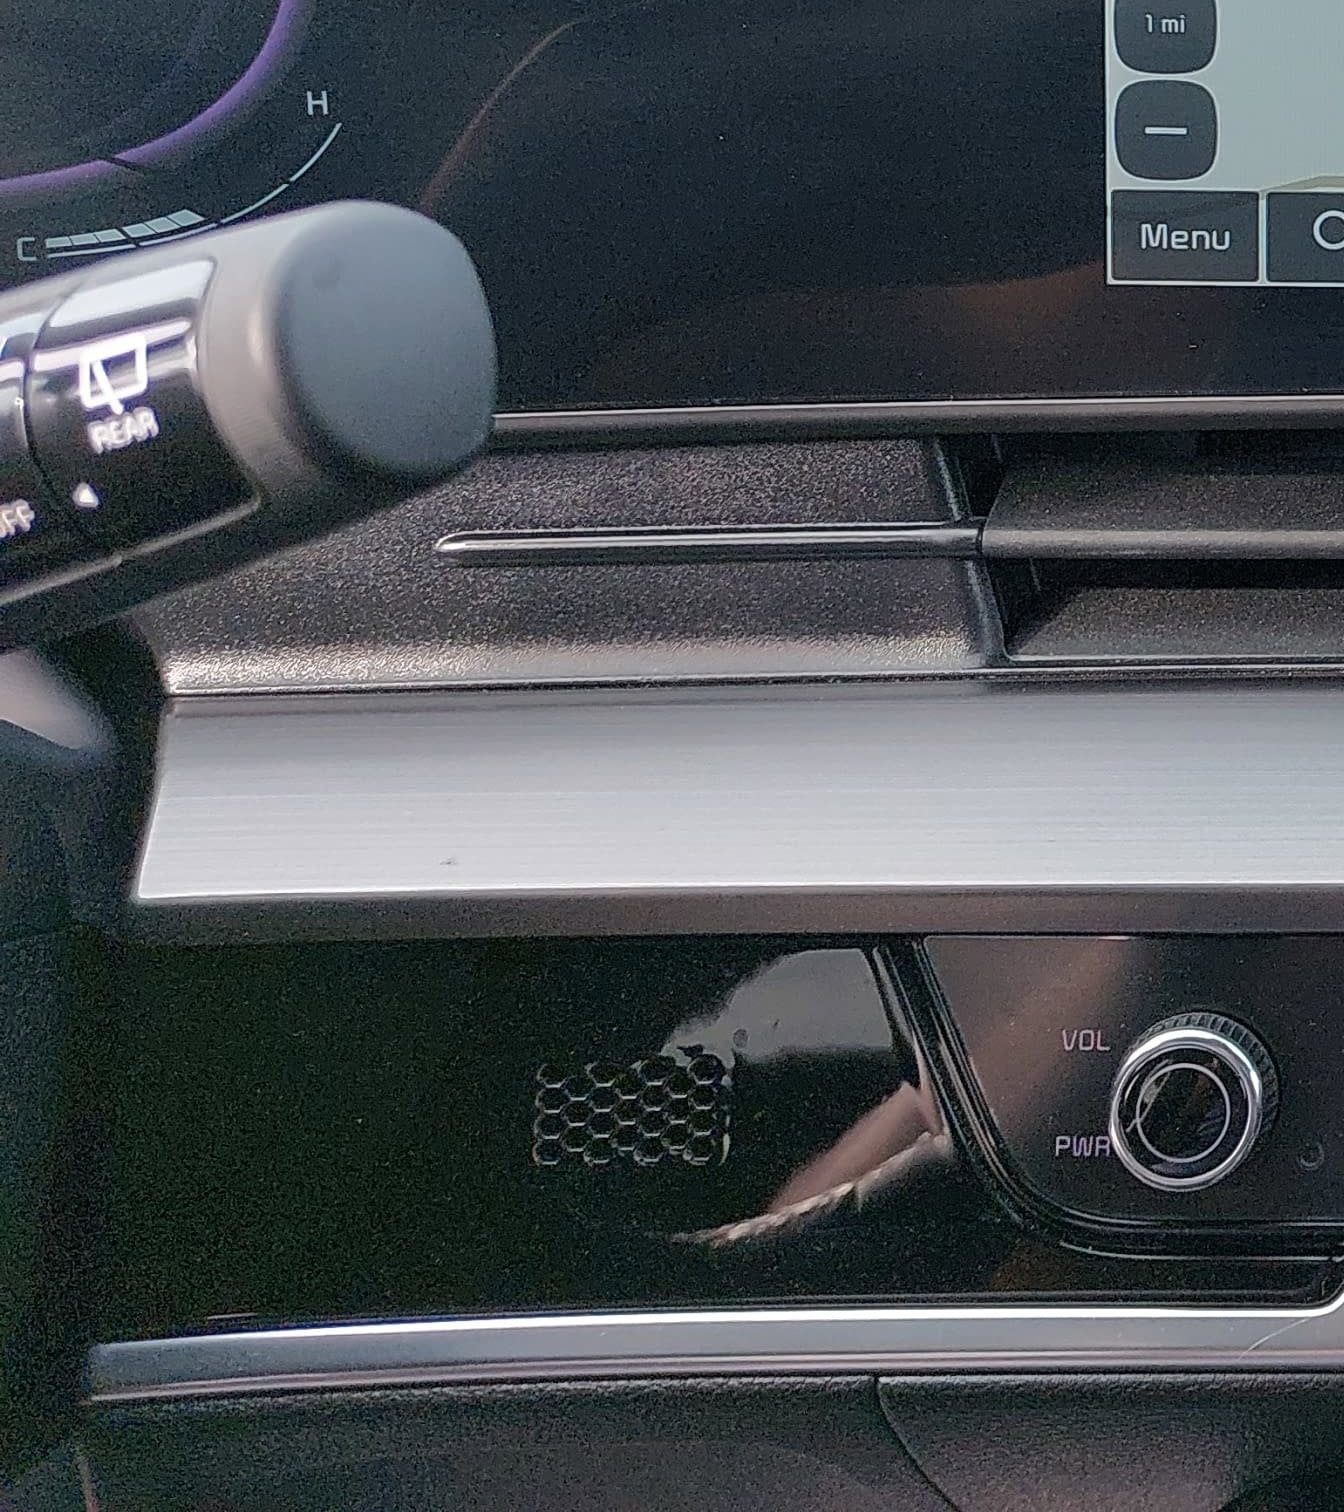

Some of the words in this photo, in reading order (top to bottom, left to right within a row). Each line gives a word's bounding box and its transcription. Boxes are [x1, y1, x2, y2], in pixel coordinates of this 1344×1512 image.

[1145, 14, 1153, 33] 1
[1161, 14, 1186, 34] mi
[306, 90, 330, 117] H
[16, 236, 38, 263] C
[1139, 222, 1232, 252] Menu
[88, 406, 160, 454] REAR
[1061, 1029, 1112, 1052] VOL
[1055, 1135, 1111, 1157] PWR
